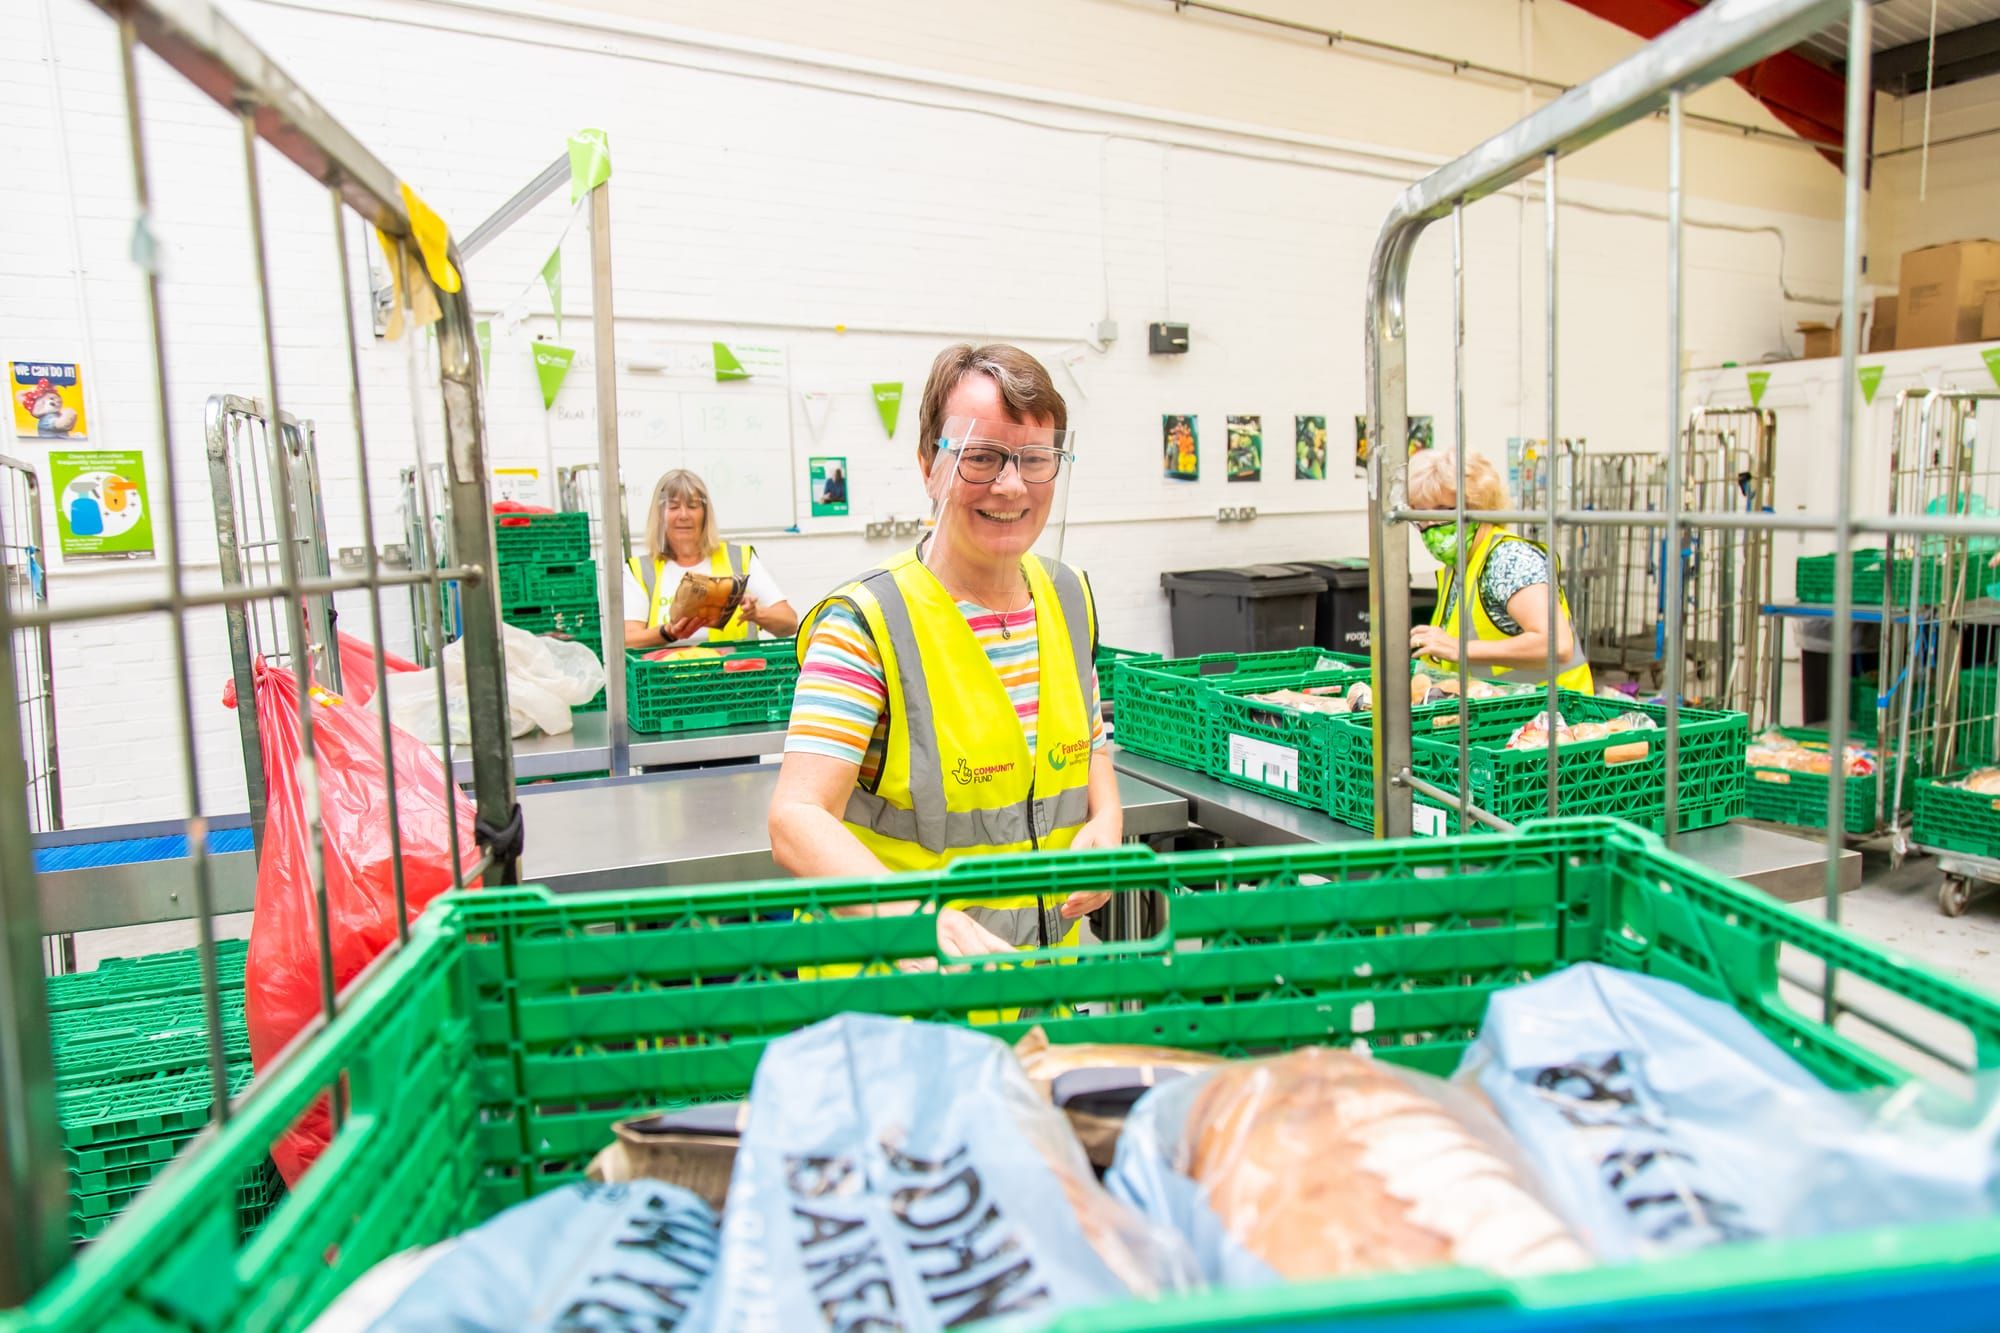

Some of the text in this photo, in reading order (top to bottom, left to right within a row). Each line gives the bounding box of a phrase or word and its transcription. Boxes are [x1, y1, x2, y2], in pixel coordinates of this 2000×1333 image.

[49, 365, 63, 377] DO
[1345, 632, 1368, 642] FOOD
[973, 762, 1015, 776] COMMUNITY
[973, 775, 993, 784] FUND
